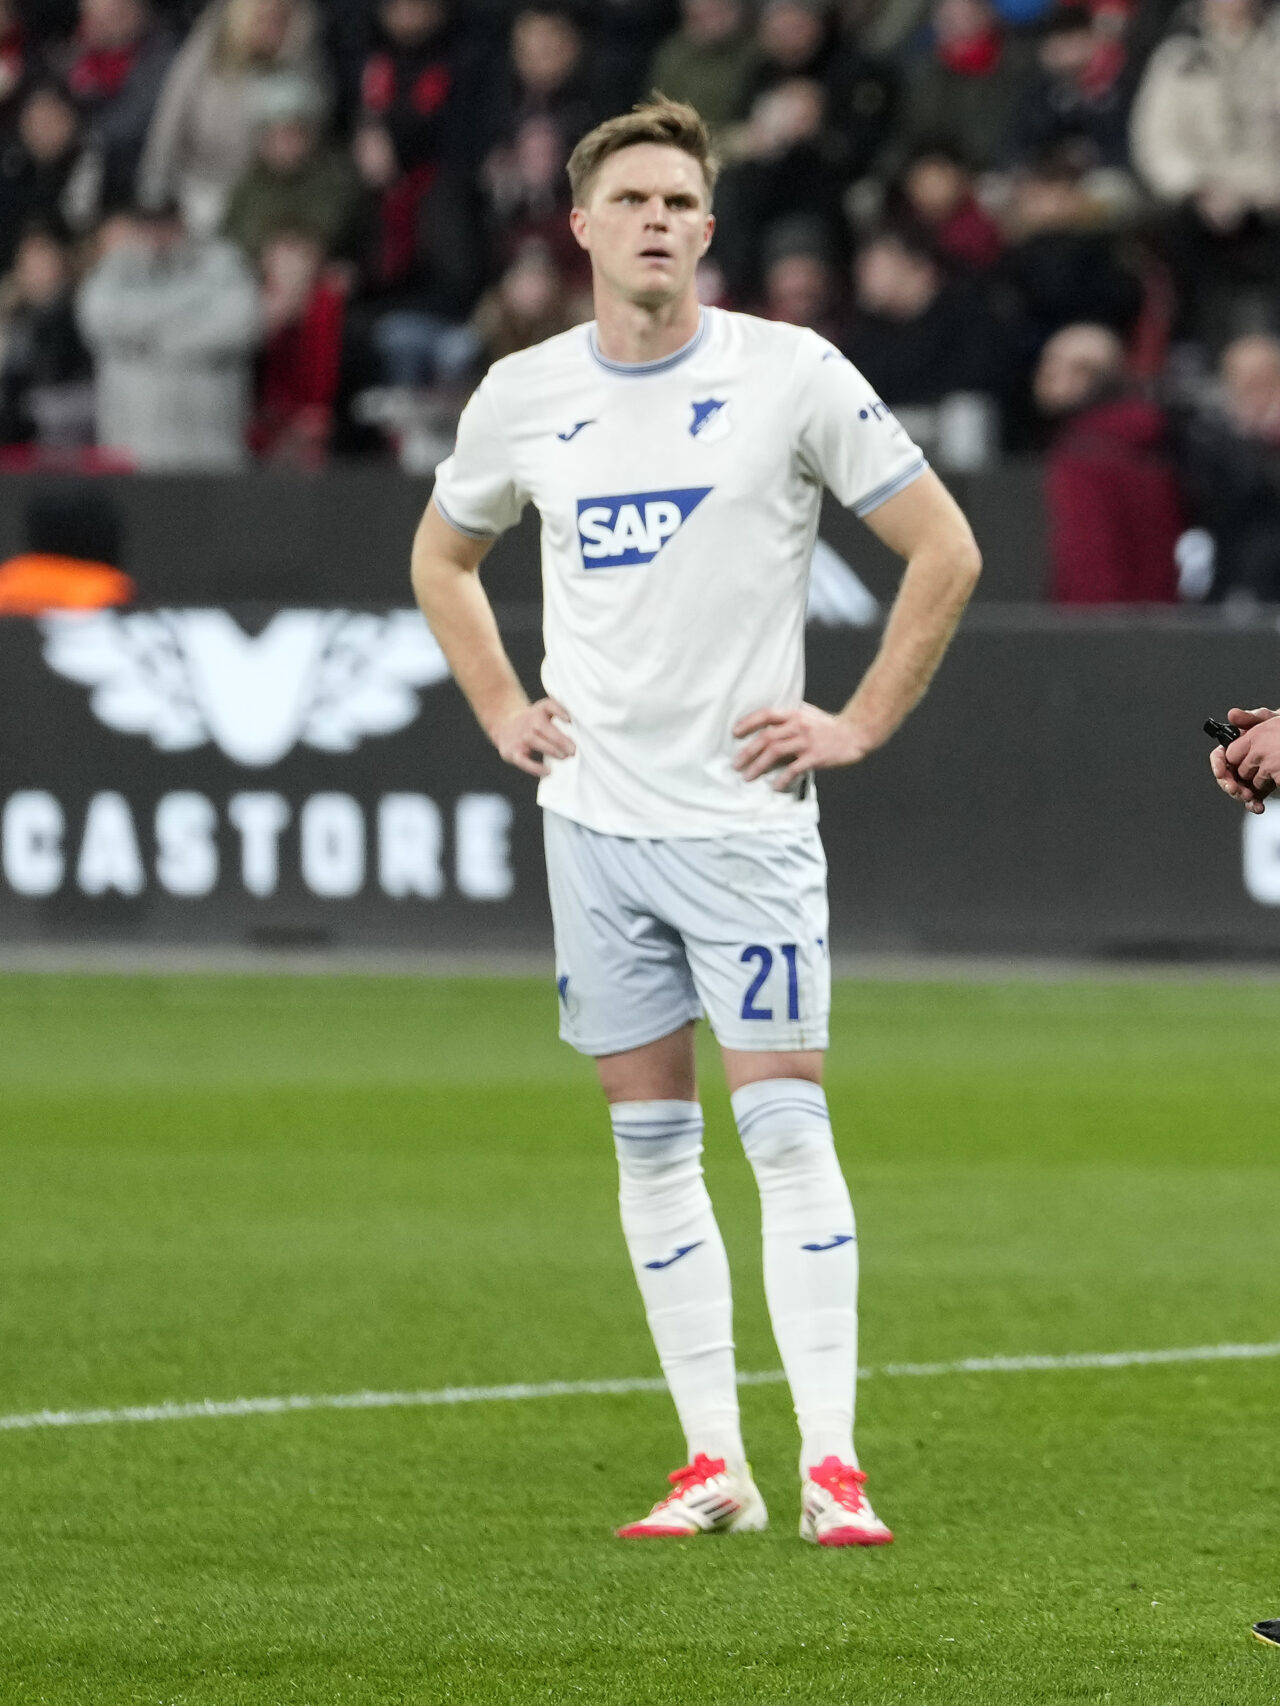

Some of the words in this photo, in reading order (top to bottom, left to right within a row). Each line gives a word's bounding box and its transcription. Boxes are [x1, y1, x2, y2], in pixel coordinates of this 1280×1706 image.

[577, 500, 682, 559] SAP
[2, 781, 514, 899] CASTORE
[740, 943, 799, 1020] 21
